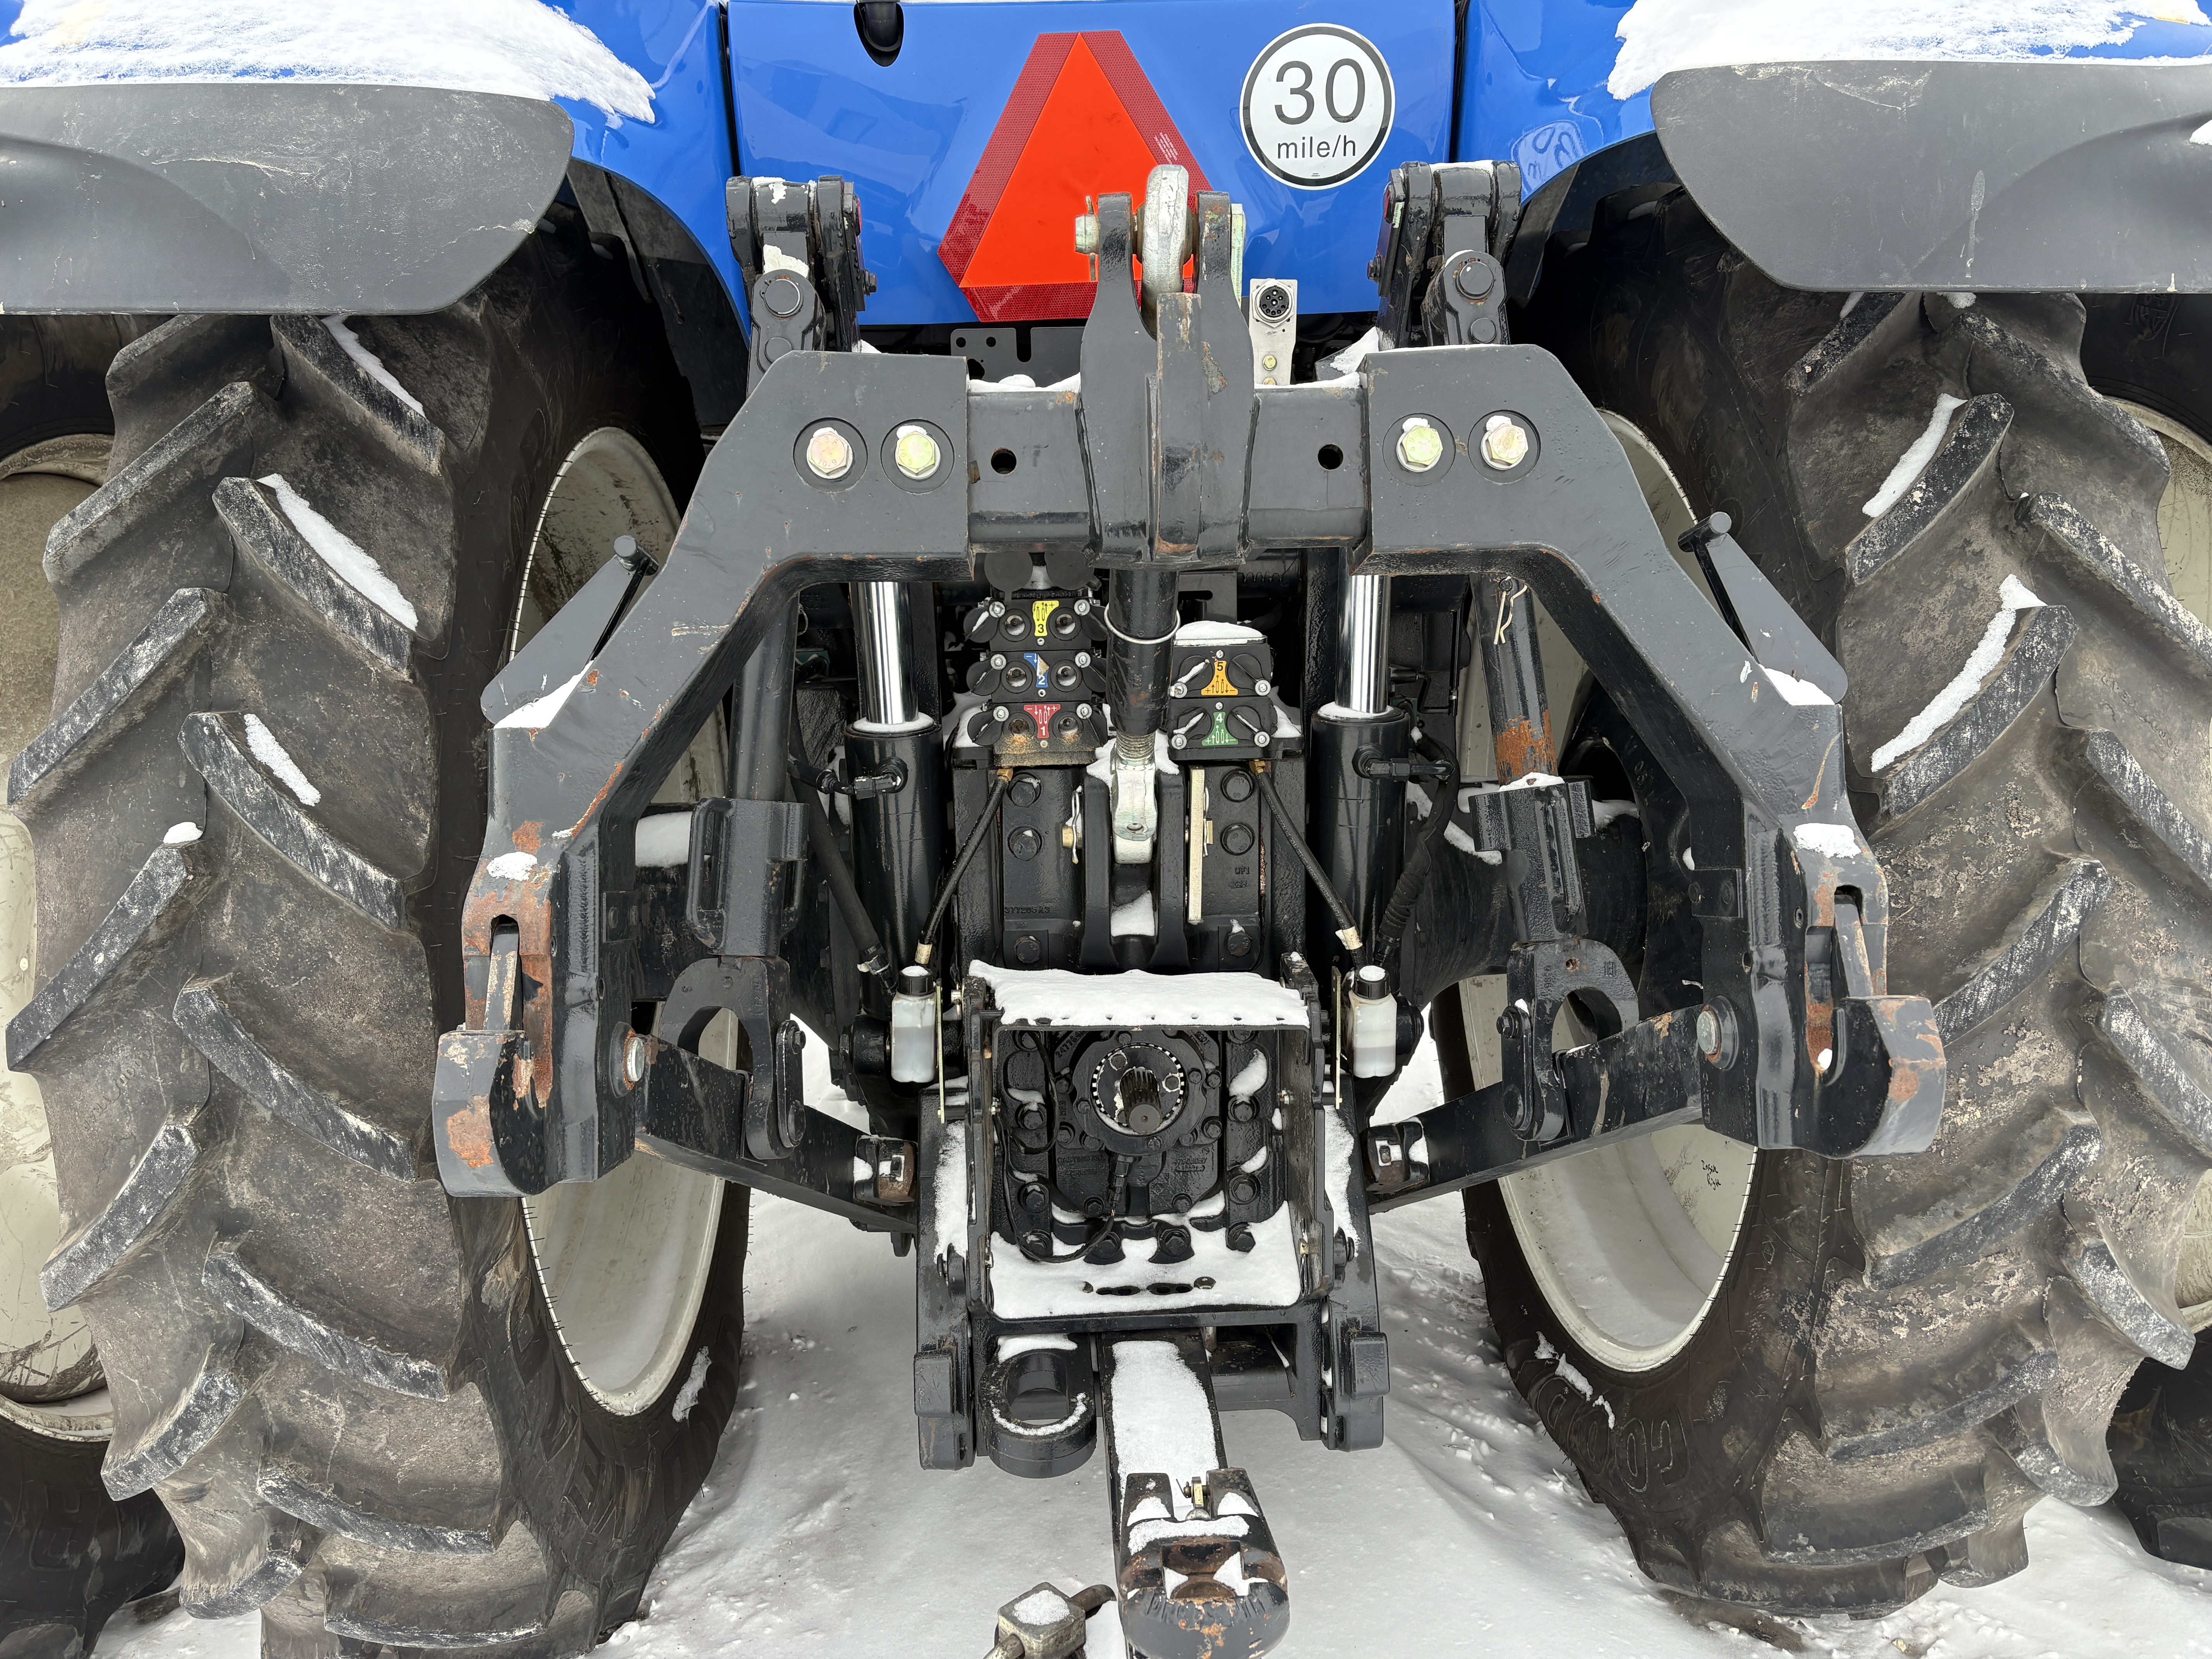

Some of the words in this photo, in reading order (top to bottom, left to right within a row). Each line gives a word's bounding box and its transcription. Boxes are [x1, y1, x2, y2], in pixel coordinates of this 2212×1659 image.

[1274, 58, 1365, 125] 30
[1278, 135, 1356, 159] mile/h
[1037, 623, 1044, 633] 3
[1217, 662, 1223, 671] 5
[1038, 675, 1045, 685] 2
[1216, 713, 1223, 723] 4
[1041, 726, 1046, 736] 1
[1275, 814, 1288, 830] MEXICO
[1289, 837, 1298, 848] MADE
[1316, 880, 1333, 903] RESISTANT
[1330, 902, 1342, 917] FLAME
